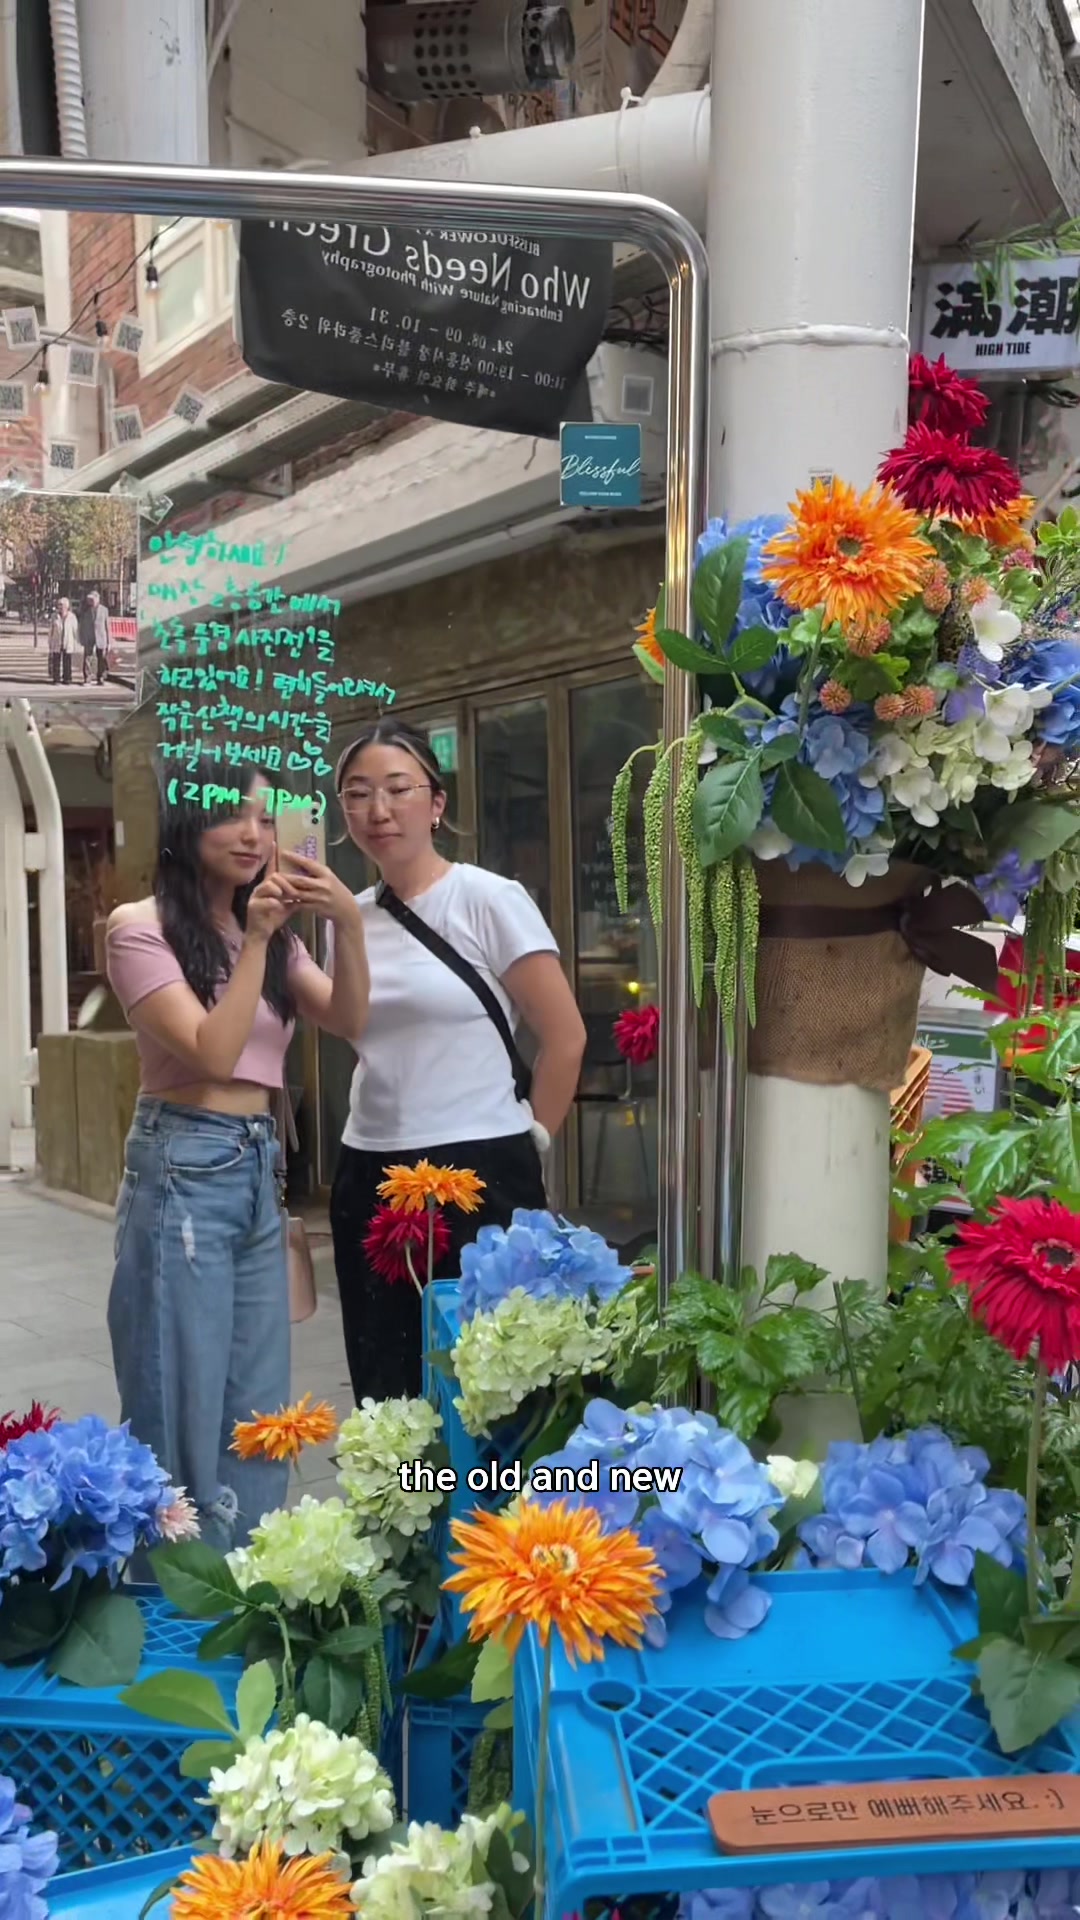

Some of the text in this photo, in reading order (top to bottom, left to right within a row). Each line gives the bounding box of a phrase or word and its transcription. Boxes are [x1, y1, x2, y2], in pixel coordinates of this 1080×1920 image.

[975, 341, 1031, 356] HIGH TIDE
[561, 454, 640, 485] Blissful
[750, 1800, 859, 1826] 눈으로만
